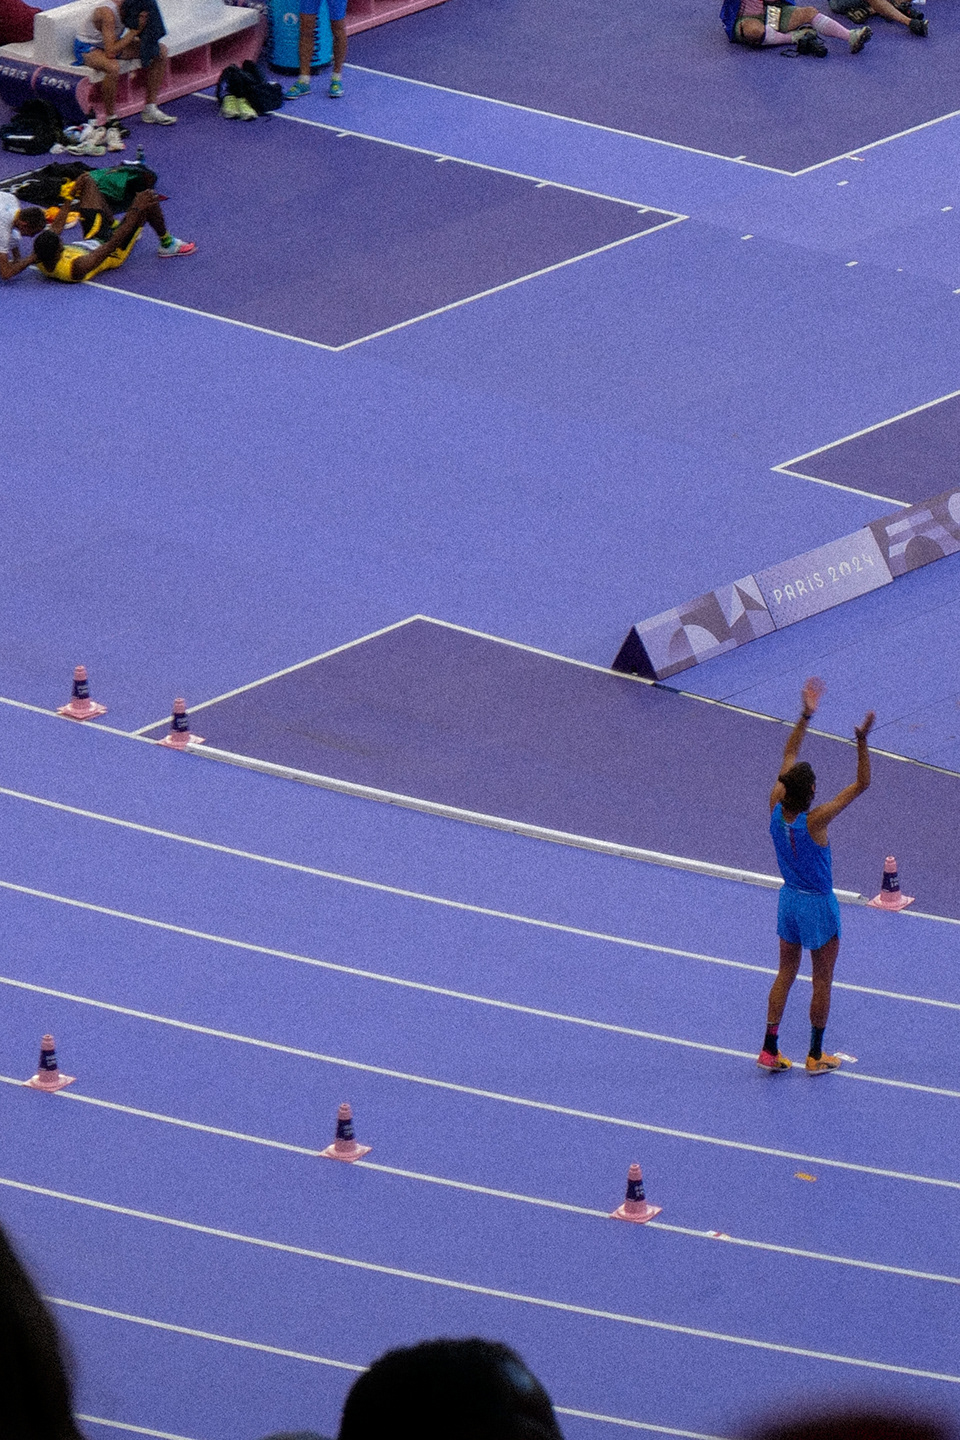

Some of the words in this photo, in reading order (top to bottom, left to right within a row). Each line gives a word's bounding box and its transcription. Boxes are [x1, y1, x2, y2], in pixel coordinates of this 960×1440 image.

[41, 76, 71, 90] 2024
[773, 572, 824, 605] PARIS
[828, 553, 875, 583] 2024
